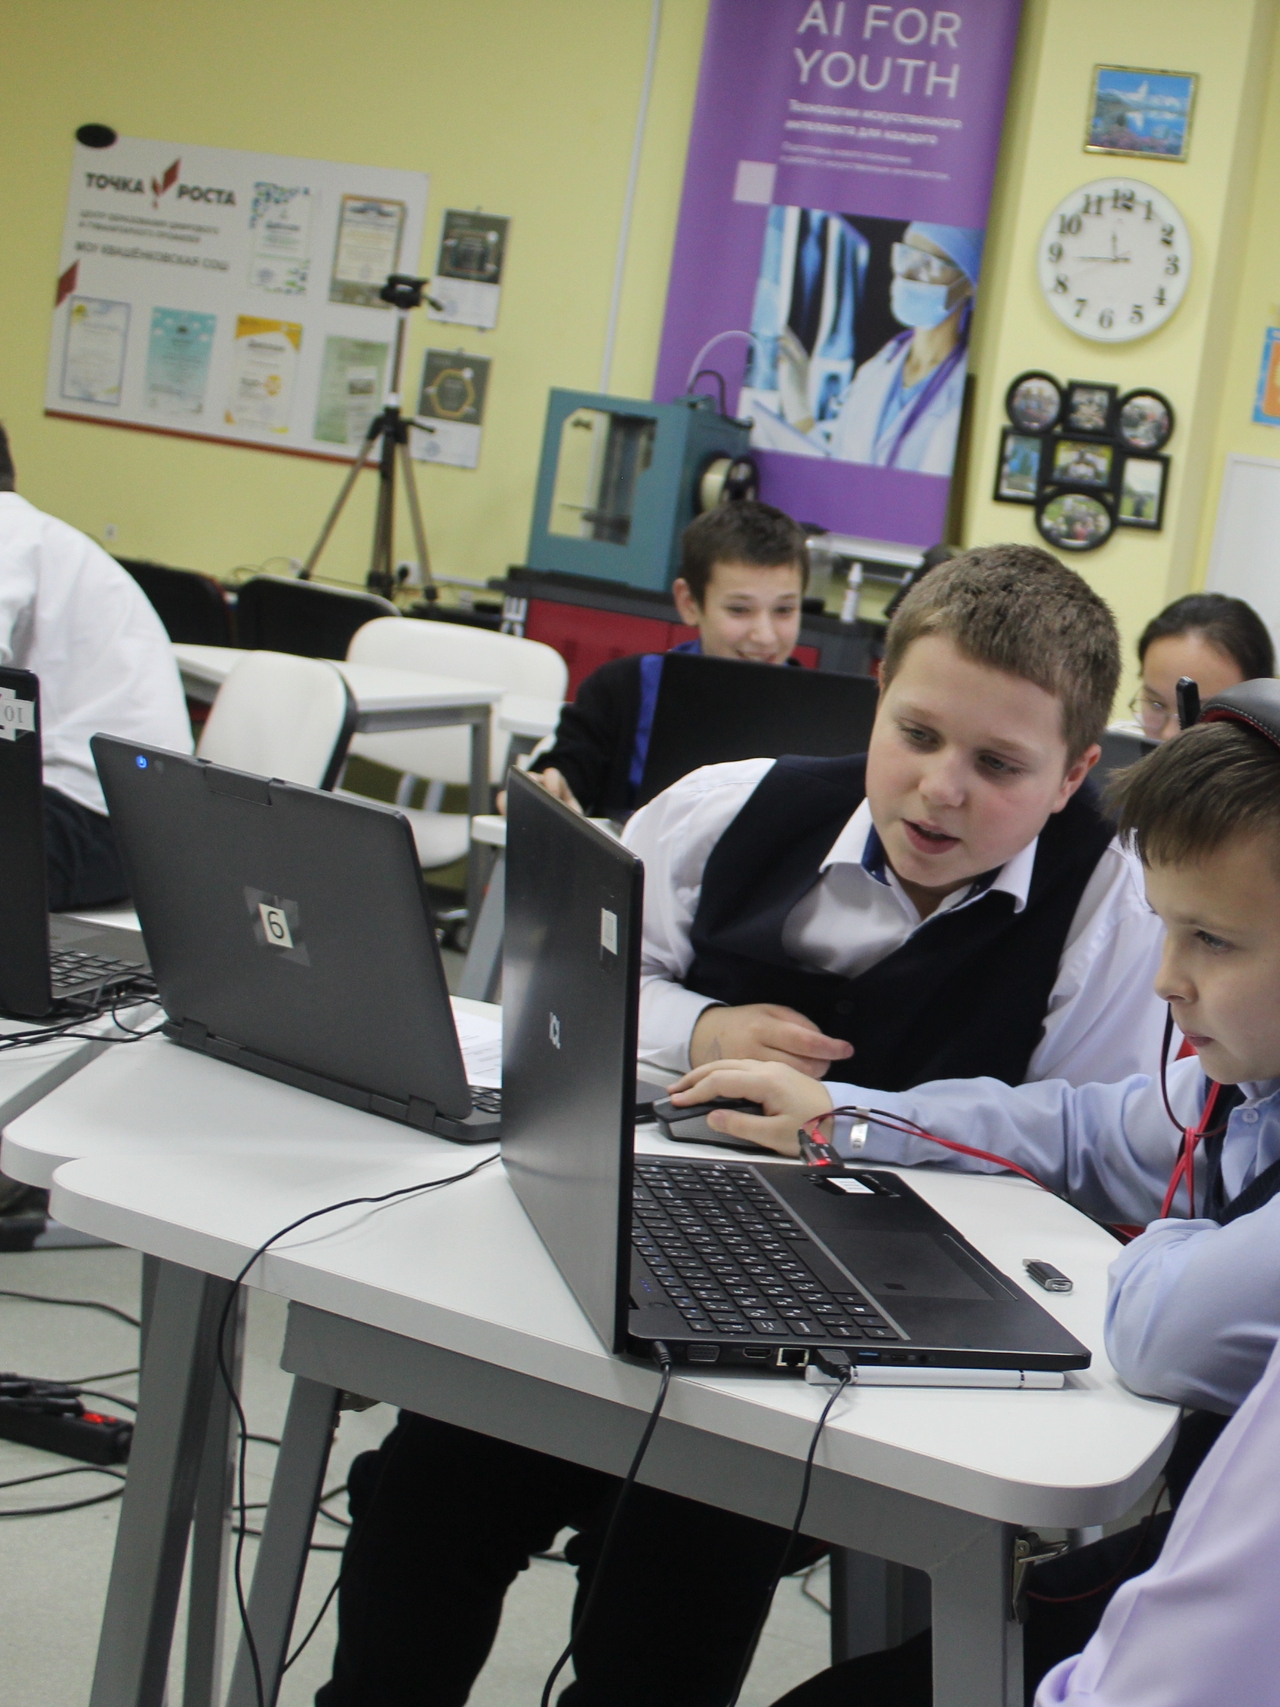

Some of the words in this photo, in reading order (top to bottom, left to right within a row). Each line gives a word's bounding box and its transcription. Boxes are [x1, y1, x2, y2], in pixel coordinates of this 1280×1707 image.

[797, 0, 846, 36] AI
[862, 4, 963, 48] FOR
[793, 47, 961, 99] YOUTH
[85, 171, 146, 194] ТОЧКА
[176, 183, 237, 206] РОСТА
[1082, 193, 1102, 216] 11
[1111, 188, 1135, 212] 12
[1144, 199, 1153, 221] 1
[1058, 213, 1082, 236] 10
[1161, 223, 1175, 247] 2
[1048, 241, 1064, 263] 9
[1164, 254, 1180, 276] 3
[1053, 273, 1069, 295] 8
[1153, 285, 1167, 306] 4
[1075, 297, 1087, 318] 7
[1099, 307, 1115, 329] 6
[1129, 304, 1144, 324] 5
